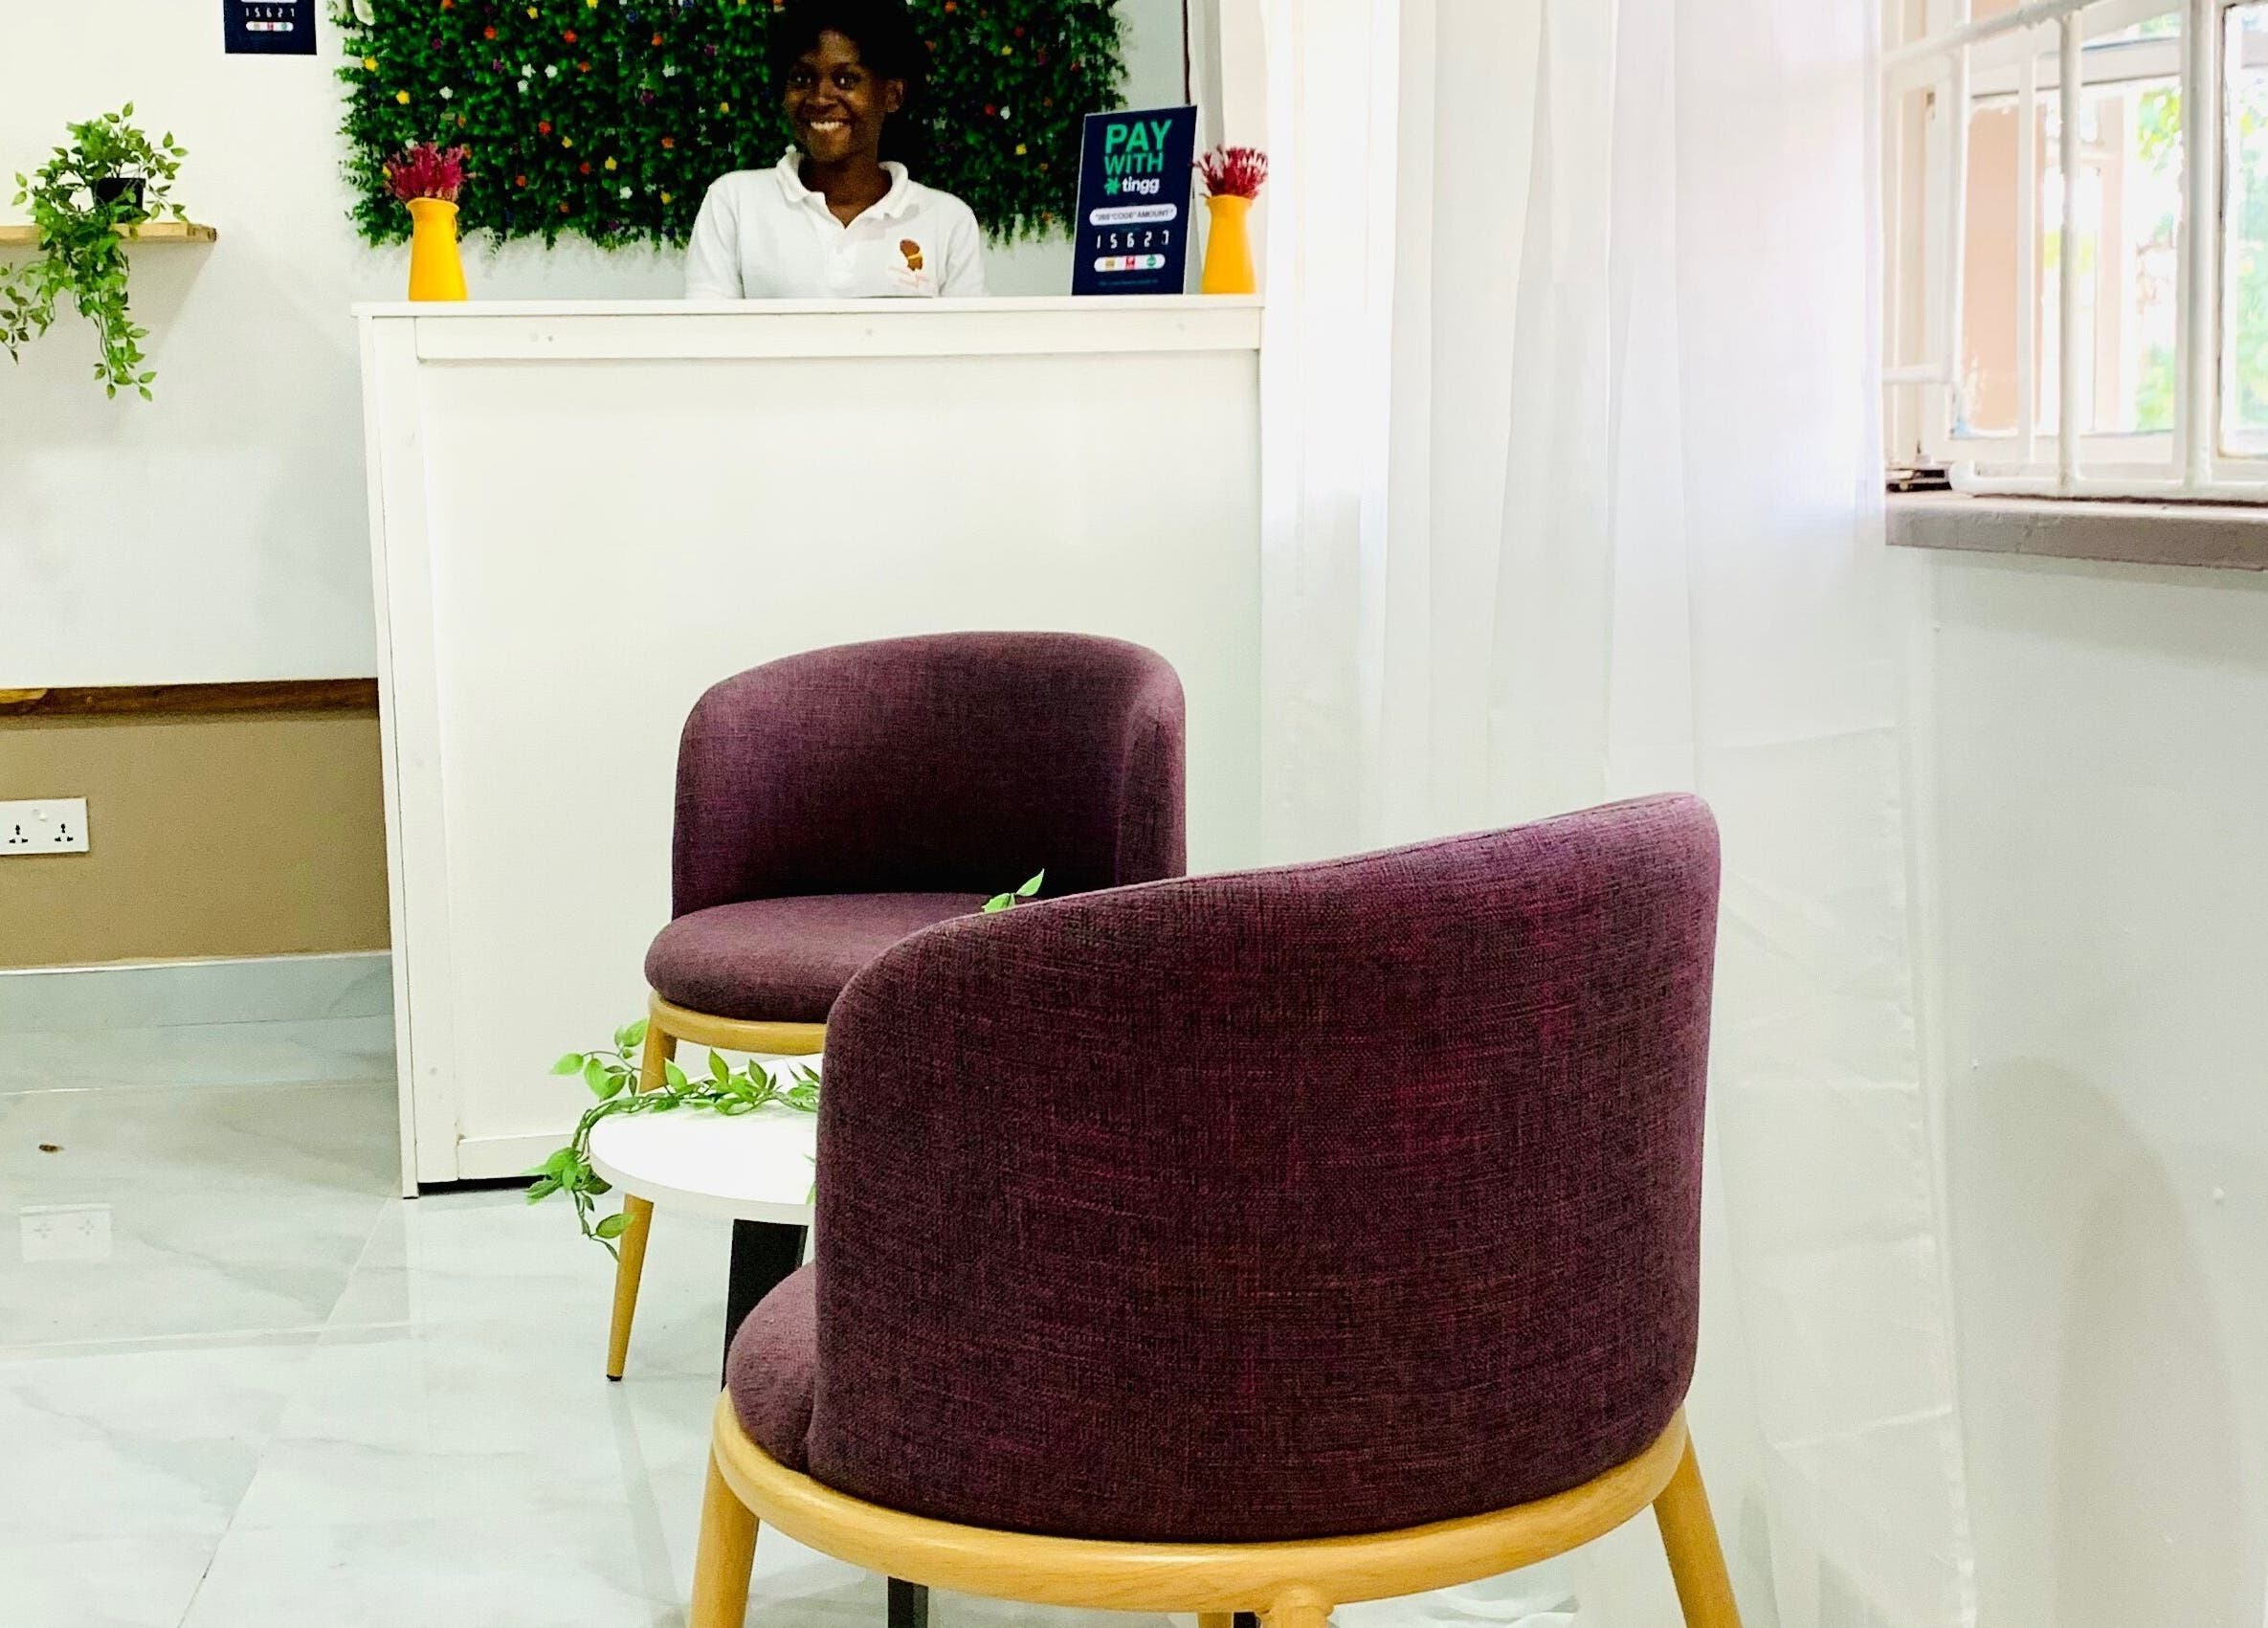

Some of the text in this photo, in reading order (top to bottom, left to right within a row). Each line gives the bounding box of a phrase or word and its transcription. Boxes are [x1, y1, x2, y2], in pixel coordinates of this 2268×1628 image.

[1105, 120, 1171, 153] PAY
[1104, 152, 1163, 175] WITH
[1122, 176, 1161, 195] tingg
